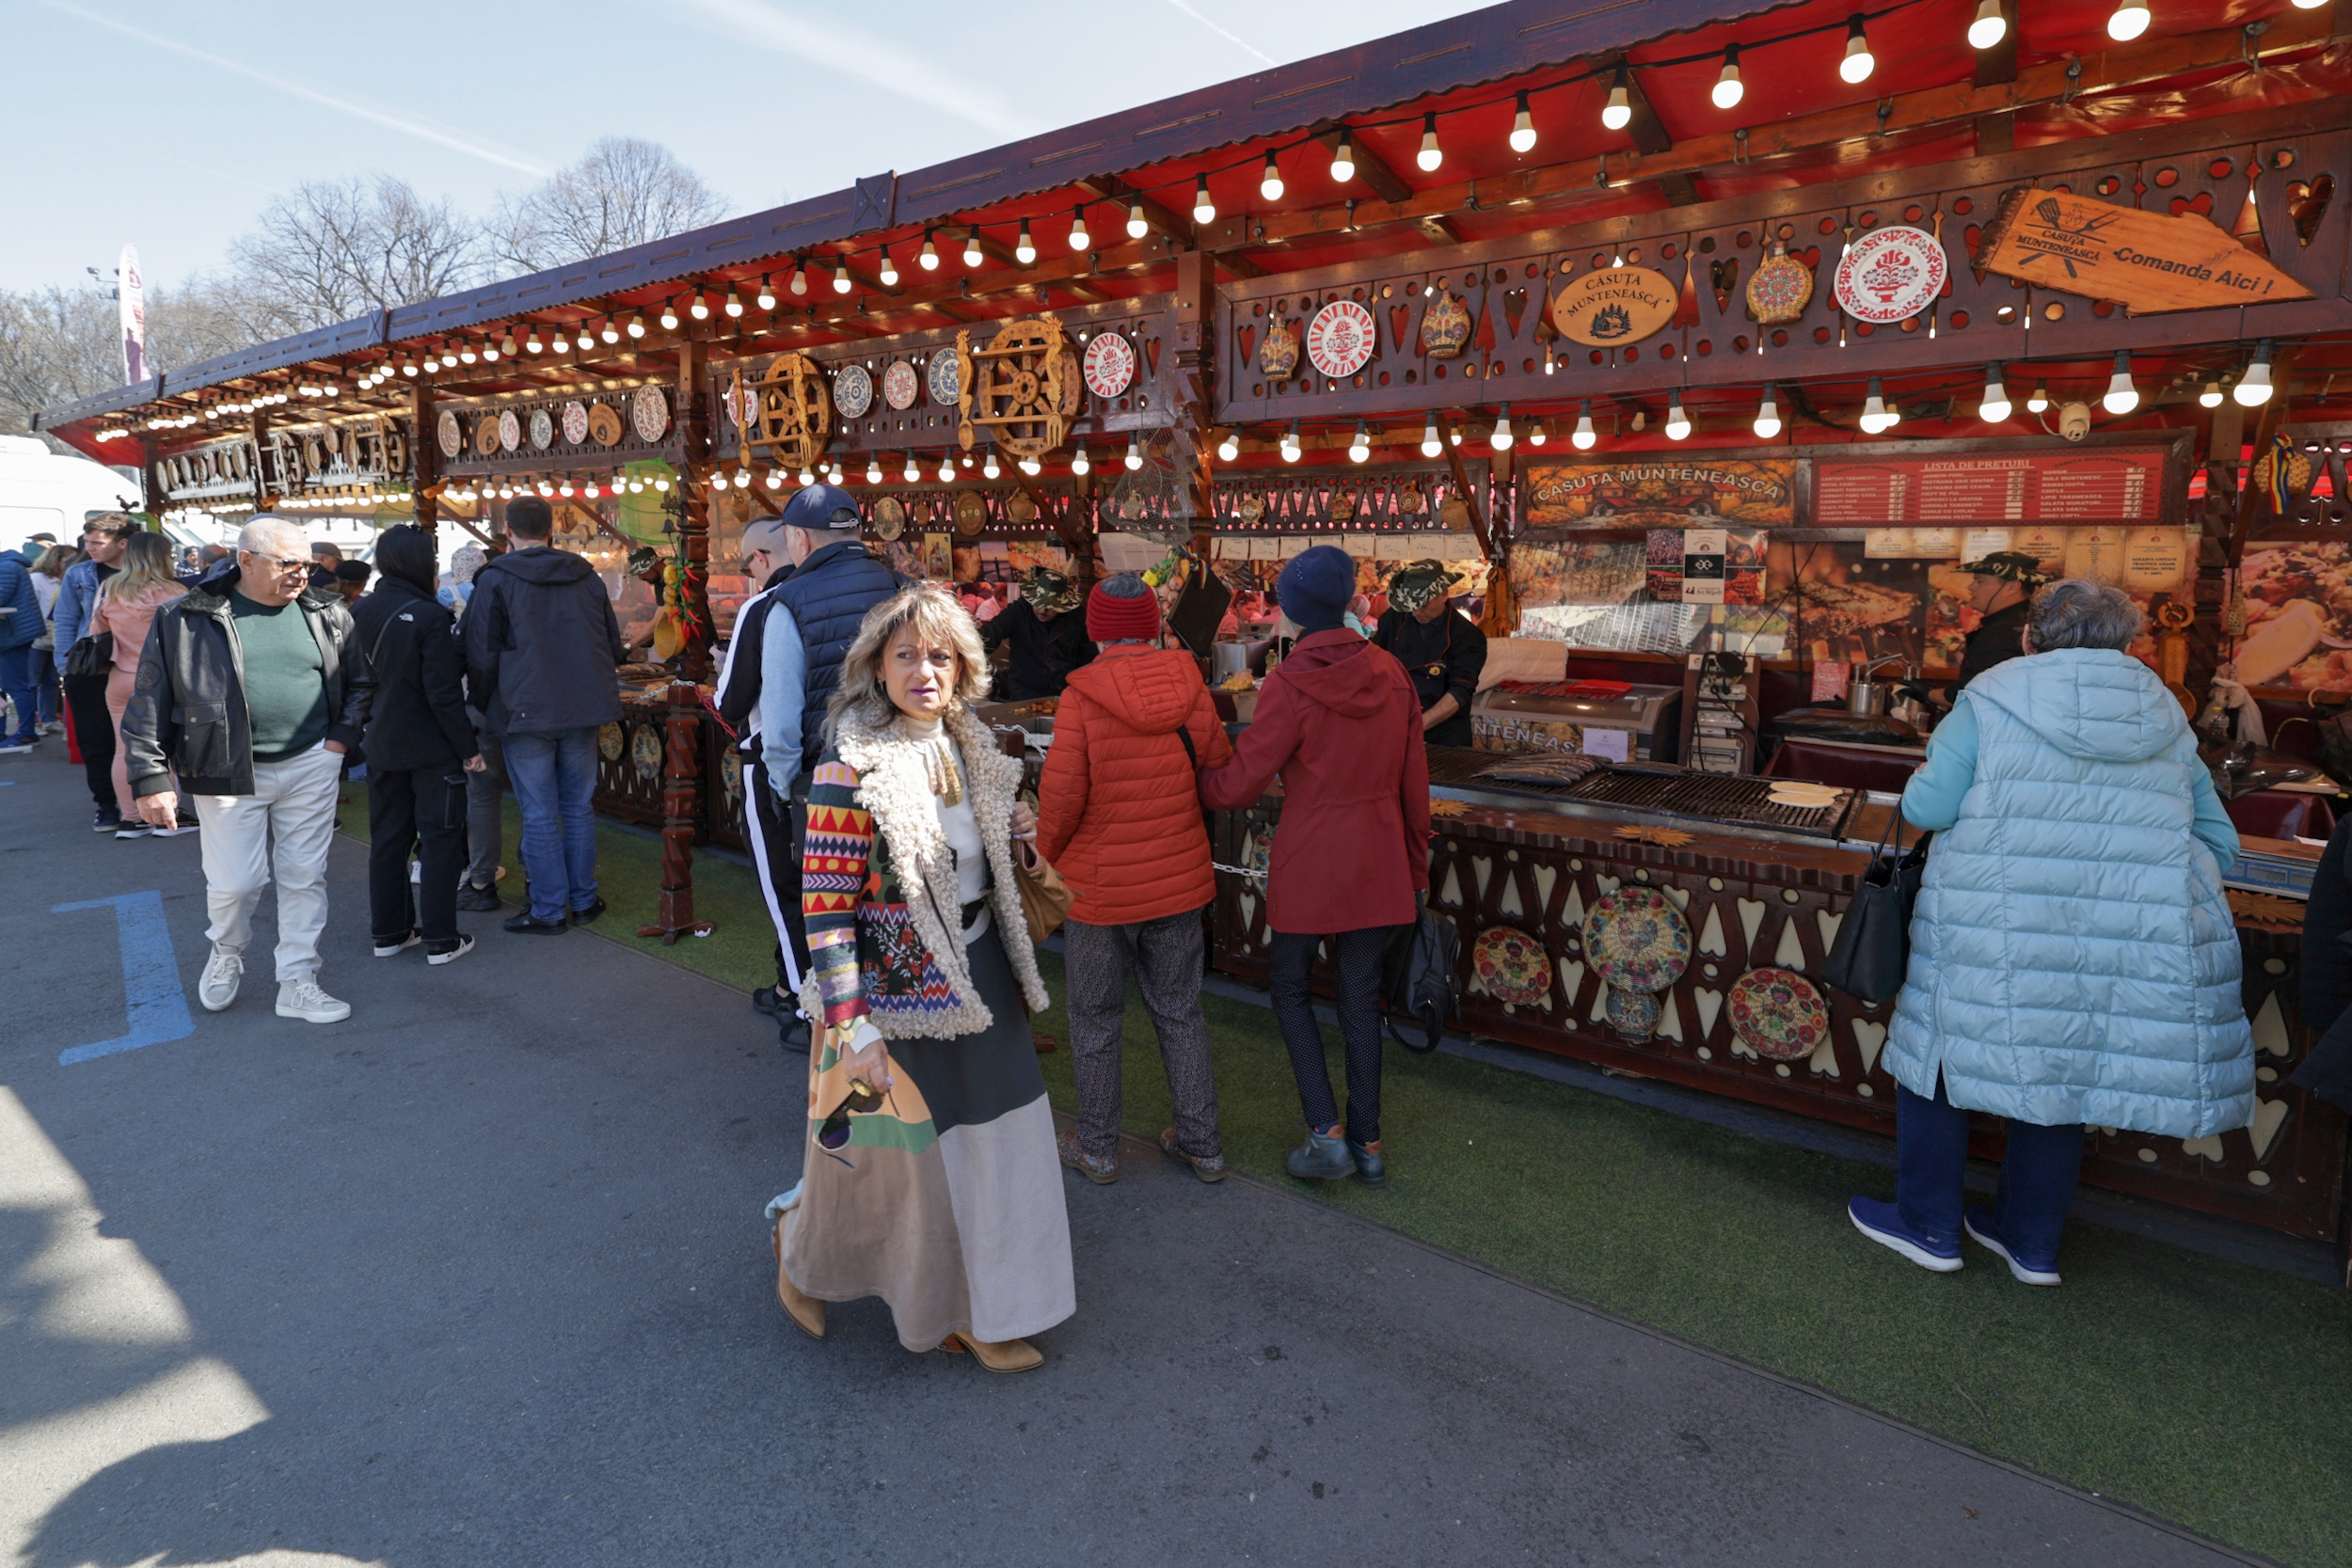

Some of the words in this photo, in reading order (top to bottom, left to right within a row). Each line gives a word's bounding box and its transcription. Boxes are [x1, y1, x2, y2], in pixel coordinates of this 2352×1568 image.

[2016, 235, 2101, 261] MUNTENEASCĂ
[2117, 247, 2212, 280] Comanda
[2215, 271, 2261, 291] Aici
[1567, 289, 1661, 316] MUNTENEASCĂ
[1977, 460, 2030, 468] PRETURI
